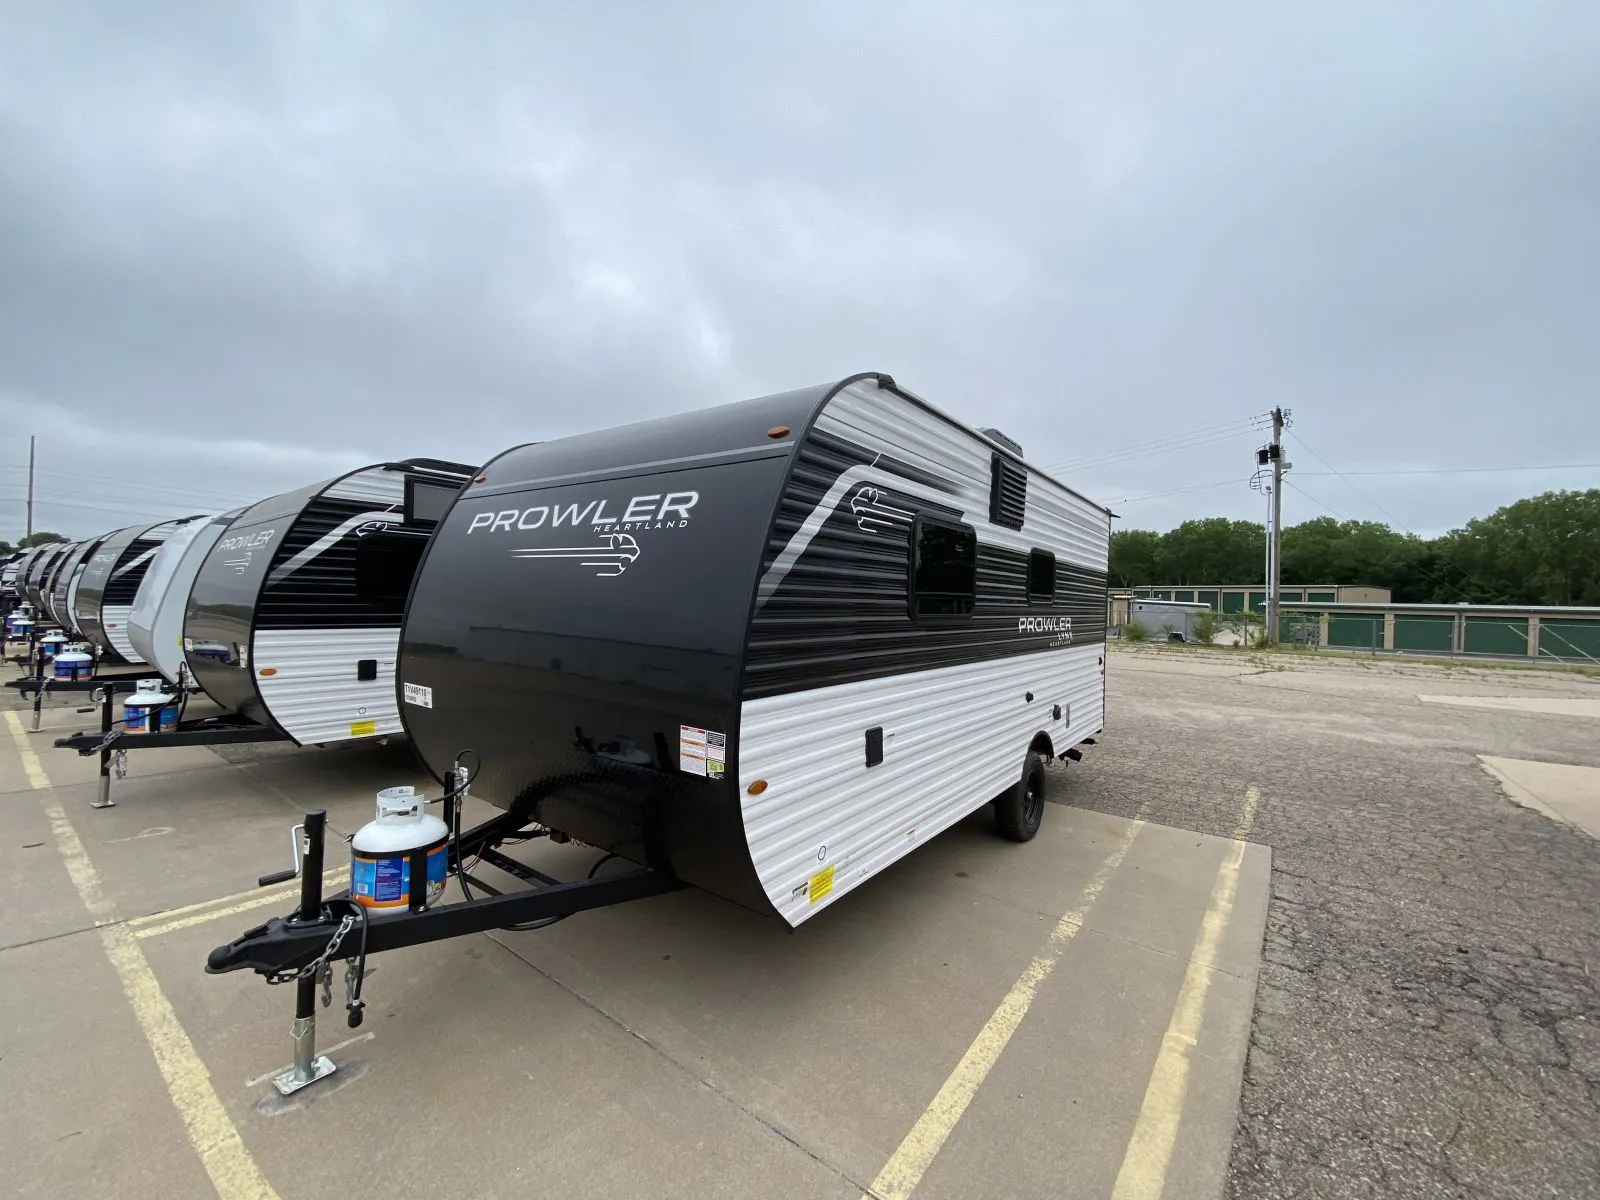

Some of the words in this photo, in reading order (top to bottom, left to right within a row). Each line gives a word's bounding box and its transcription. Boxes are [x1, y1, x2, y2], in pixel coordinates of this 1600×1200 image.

[466, 491, 699, 535] PROWLER
[593, 520, 688, 532] HEARTLAND
[1018, 617, 1071, 632] PROWLER
[1057, 631, 1073, 640] LYNX
